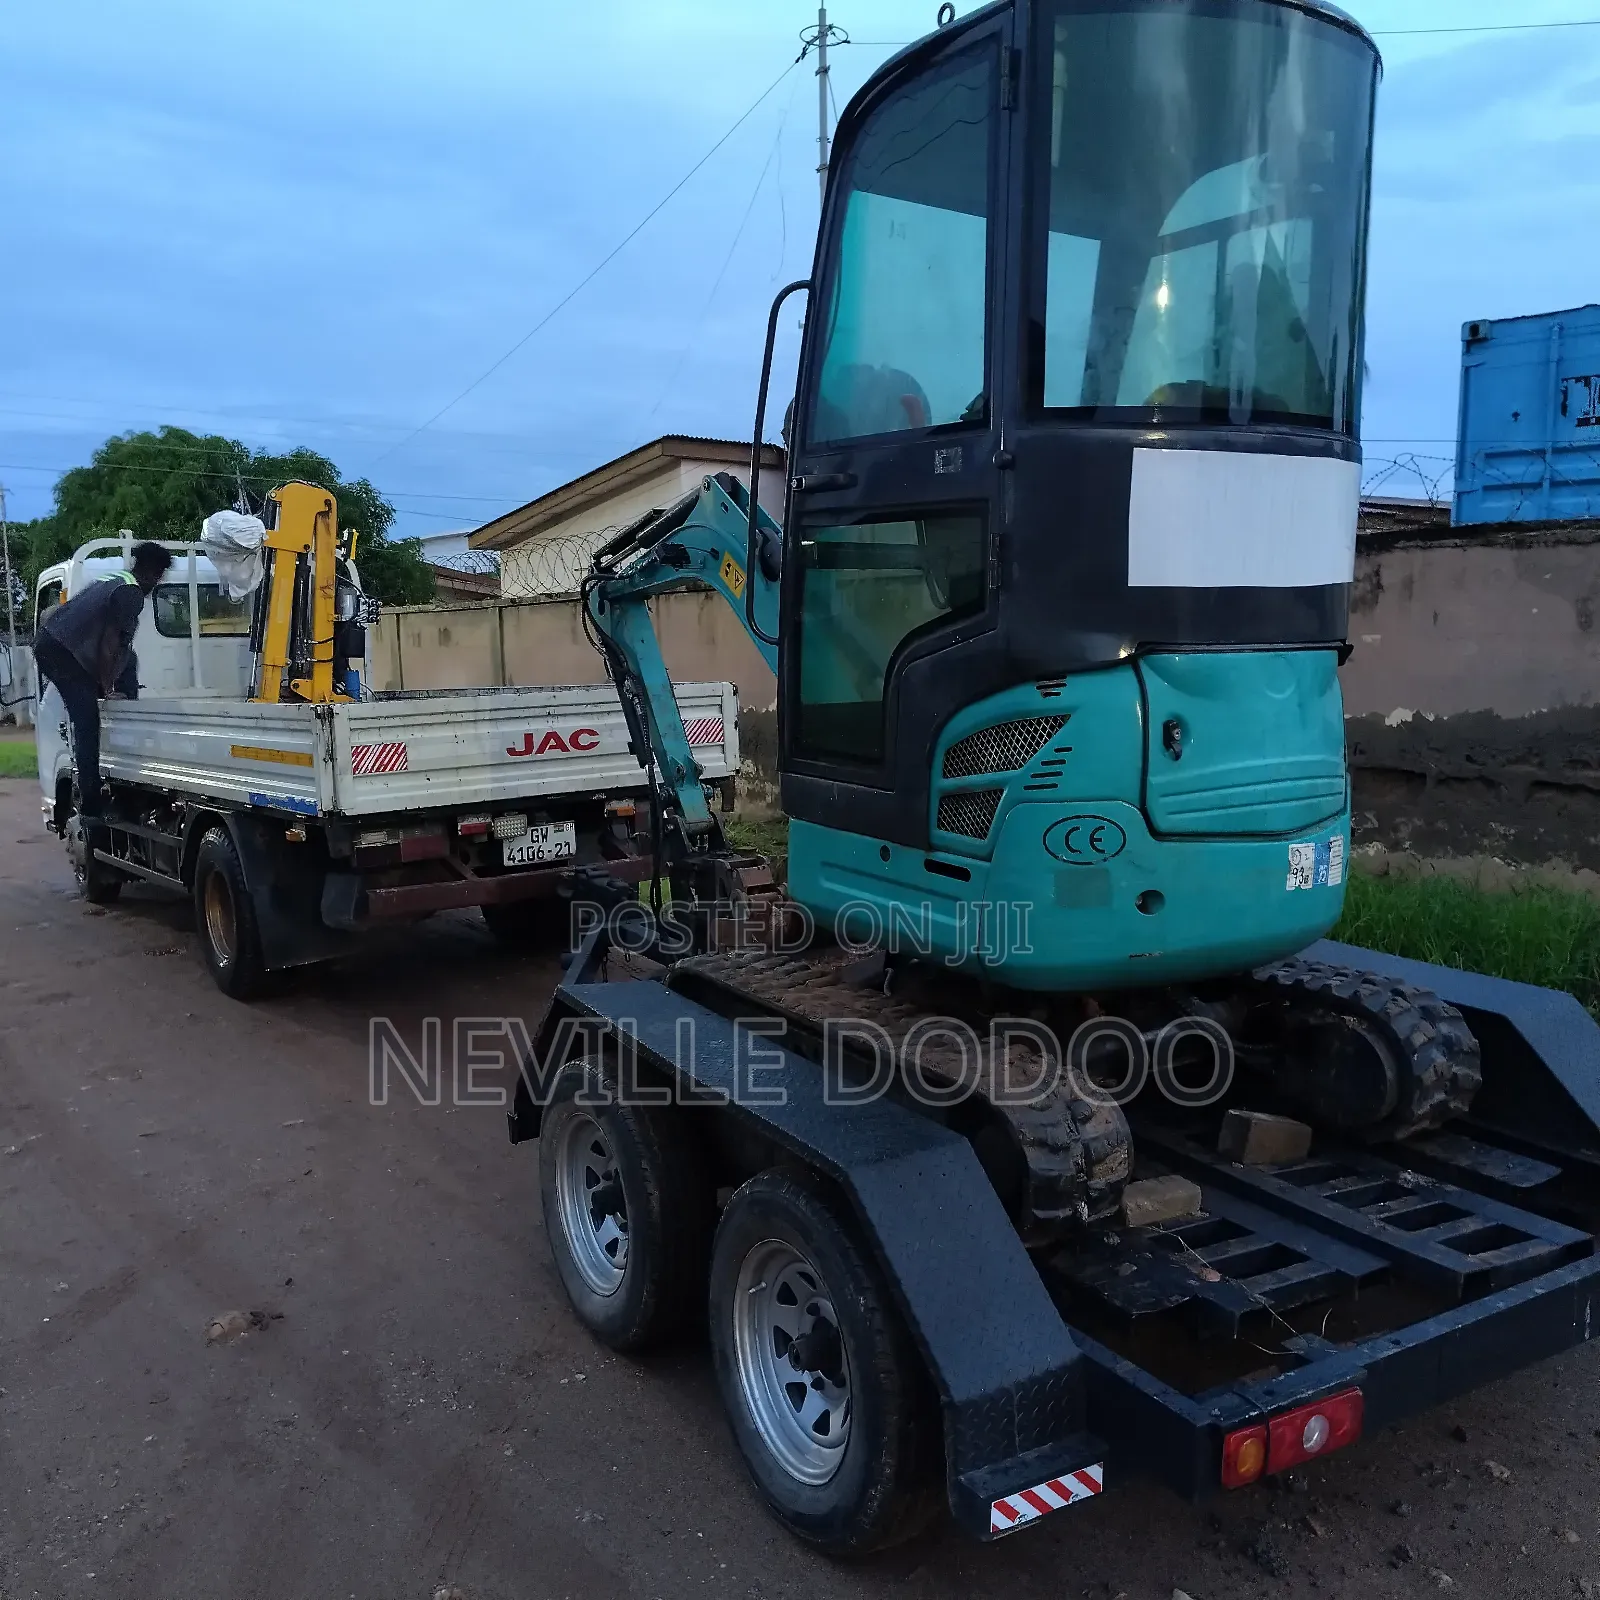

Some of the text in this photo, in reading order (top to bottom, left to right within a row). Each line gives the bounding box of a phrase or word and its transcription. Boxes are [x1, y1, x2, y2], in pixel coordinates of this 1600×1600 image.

[506, 728, 601, 757] JAC
[530, 827, 549, 844] GW
[1064, 825, 1106, 854] CE
[507, 841, 574, 864] 4106-21
